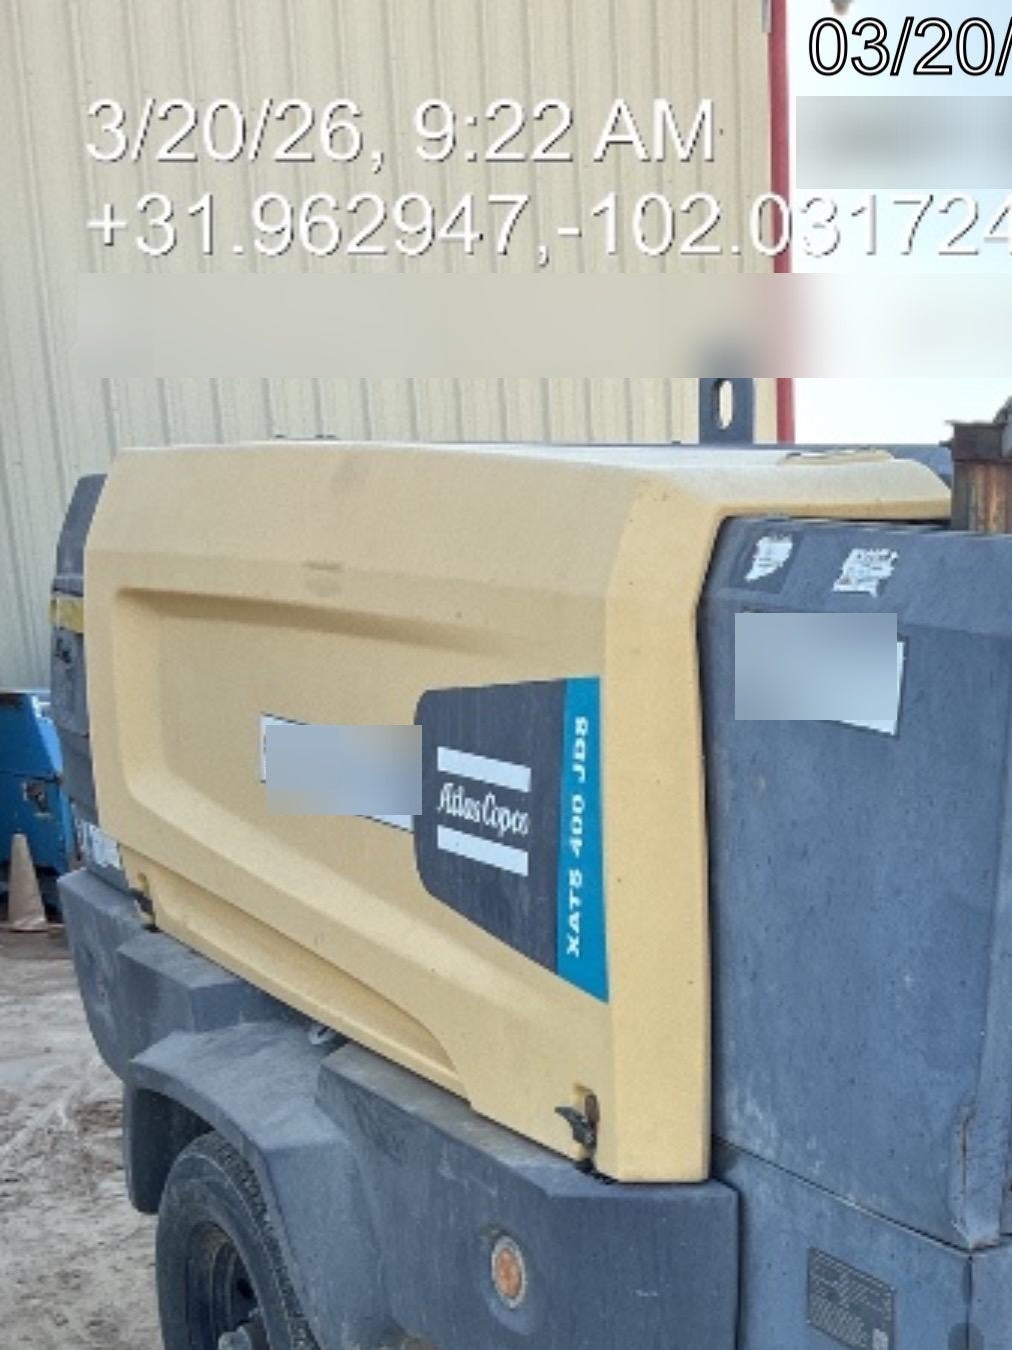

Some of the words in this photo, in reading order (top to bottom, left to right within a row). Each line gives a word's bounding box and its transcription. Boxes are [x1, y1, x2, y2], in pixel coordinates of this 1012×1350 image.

[437, 782, 481, 825] Atlas
[481, 792, 530, 837] Copco
[570, 795, 585, 858] 400
